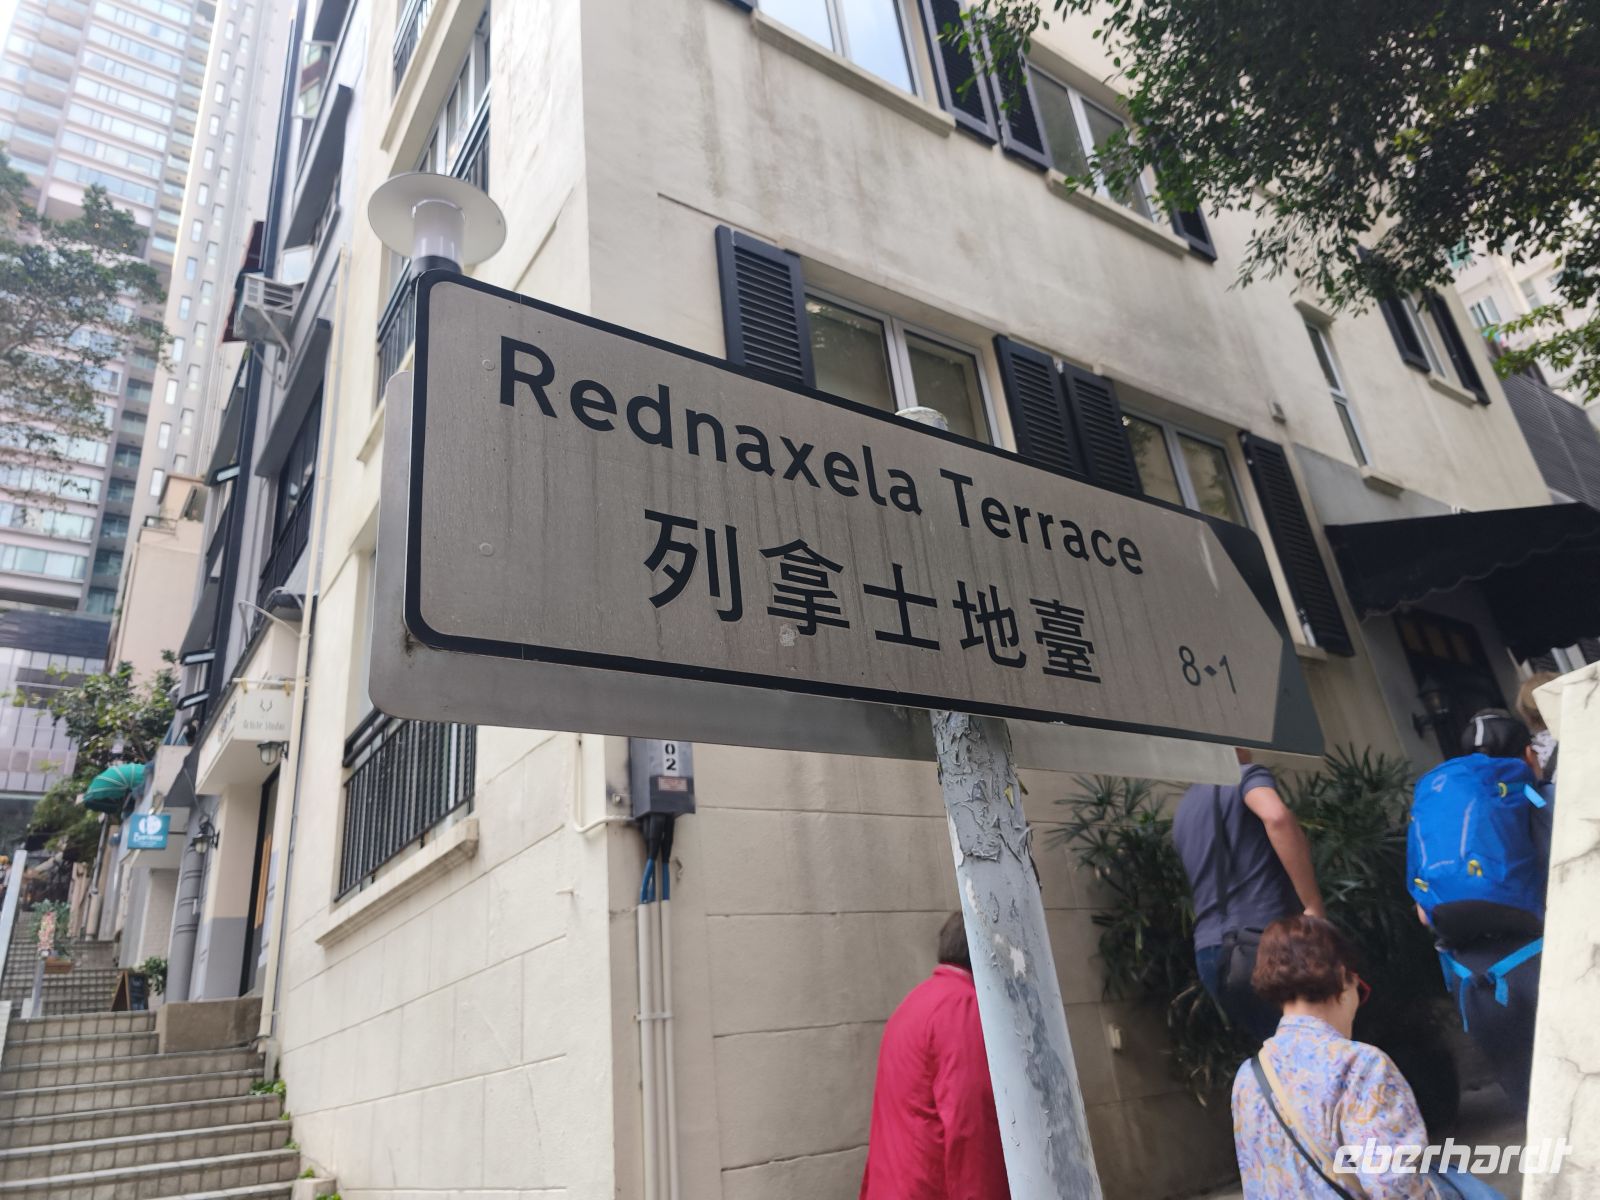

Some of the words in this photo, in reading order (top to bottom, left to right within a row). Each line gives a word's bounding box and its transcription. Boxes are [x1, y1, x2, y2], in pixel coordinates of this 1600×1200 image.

[500, 336, 923, 517] Rednaxela
[939, 468, 1144, 575] Terrace
[644, 509, 1102, 684] 列拿士地臺
